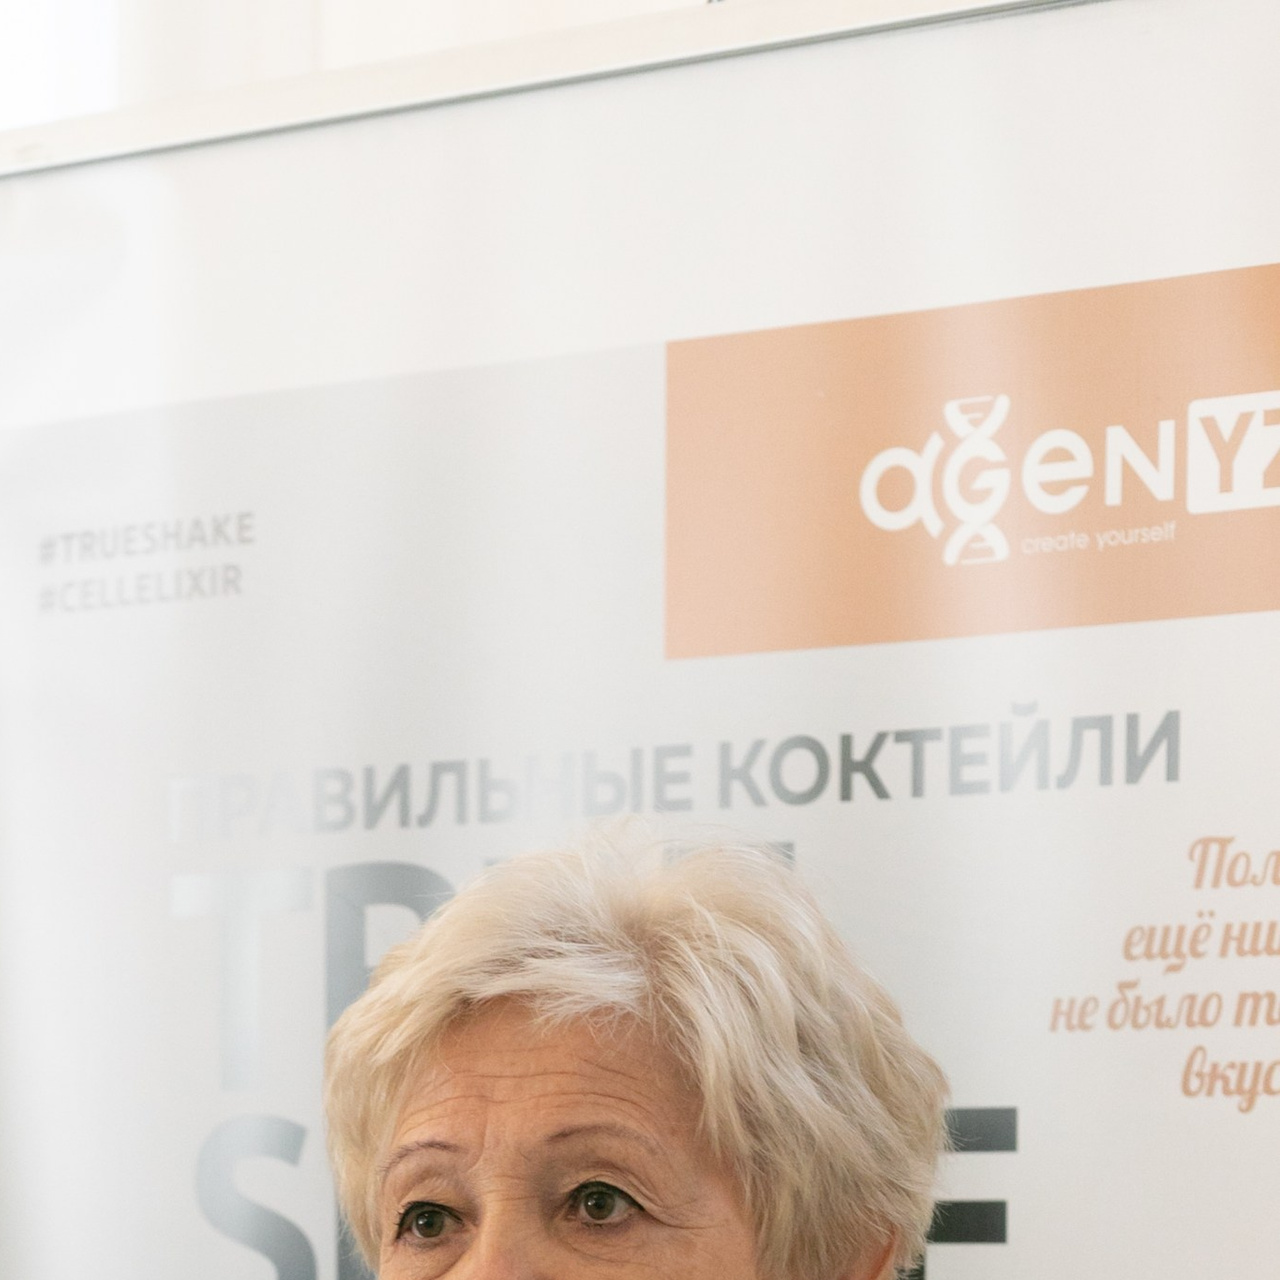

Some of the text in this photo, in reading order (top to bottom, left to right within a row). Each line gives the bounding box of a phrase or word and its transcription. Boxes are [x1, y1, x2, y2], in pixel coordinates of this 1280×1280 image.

[38, 511, 256, 565] #TRUESHAKE
[1022, 520, 1177, 555] create yourself
[38, 563, 243, 615] #CELLELIXIR
[717, 702, 1182, 810] КОКТЕЙЛИ
[1122, 910, 1212, 976] ещё
[1049, 994, 1100, 1033] не
[1106, 979, 1223, 1031] было
